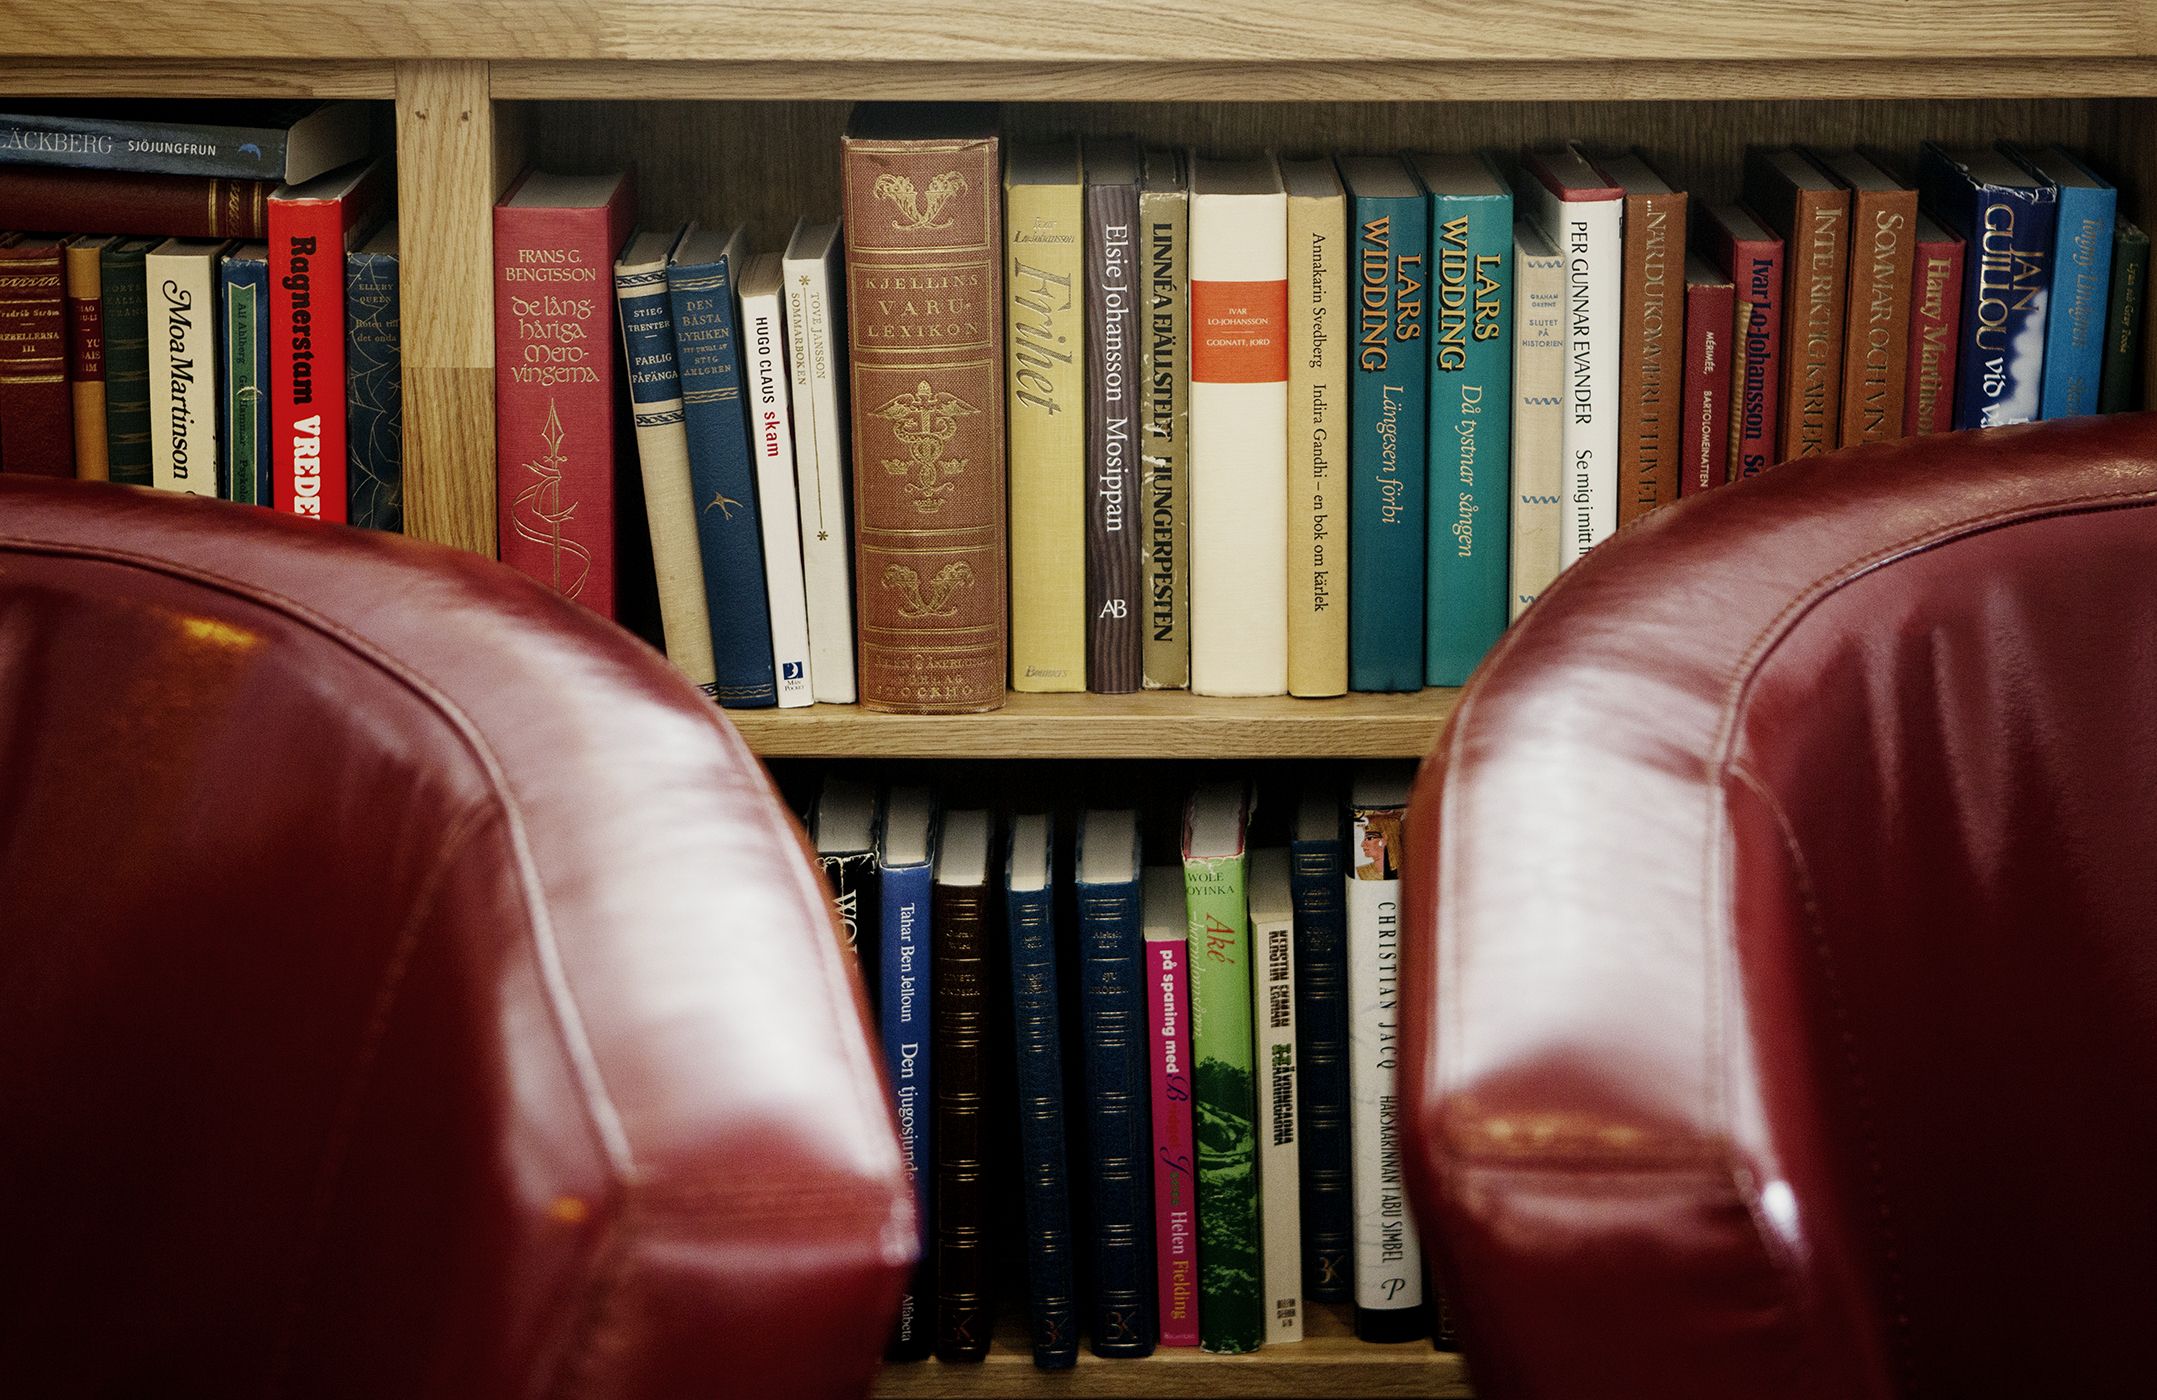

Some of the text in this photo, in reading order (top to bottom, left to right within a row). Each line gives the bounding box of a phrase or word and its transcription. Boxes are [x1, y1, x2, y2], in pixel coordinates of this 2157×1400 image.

[128, 140, 216, 156] SJÖJUNGFRUN
[519, 250, 582, 263] FRANS G.
[1571, 220, 1587, 253] PER
[1812, 206, 1842, 270] INTE
[506, 268, 596, 282] BENGTSSON
[865, 275, 978, 289] KJELLINS
[1152, 222, 1176, 309] LINNÉA
[1312, 232, 1328, 304] Annakarin
[1751, 258, 1773, 299] Ivar
[1870, 210, 1904, 324] SOMMAR
[1976, 204, 2015, 352] GUILLOU
[2008, 245, 2046, 312] JAN
[686, 300, 713, 311] DEN
[1359, 216, 1390, 373] WIDDING
[1396, 252, 1422, 341] LARS
[1437, 215, 1468, 373] WIDDING
[1473, 252, 1501, 341] LARS
[1572, 258, 1589, 335] GUNNAR
[1920, 257, 1952, 320] Harry
[628, 320, 670, 333] TRENTER
[633, 307, 663, 318] STIEG
[868, 325, 978, 337] LEXIKON
[1208, 318, 1269, 326] LO-JOHANSSON
[1529, 319, 1558, 327] SLUTET
[1538, 328, 1549, 336] PÅ
[679, 328, 729, 342] LYRIKEN
[791, 292, 806, 386] SOMMARBOKEN
[810, 292, 826, 379] TOVE JANSSON
[1014, 257, 1073, 416] Frihet
[1206, 338, 1270, 348] GODNATT, JORD
[1309, 307, 1327, 369] Svedberg
[1522, 339, 1564, 348] HISTORIEN
[162, 280, 194, 480] Moa Martinson
[283, 236, 321, 520] Ragnerstam VREDE
[632, 370, 678, 384] FÅFÄNGA
[636, 353, 672, 366] FARLIG
[695, 356, 719, 365] STIG
[1100, 223, 1129, 532] Elsie Johansson Mosippan
[1744, 302, 1772, 440] Lo-Johansson
[1982, 357, 2006, 398] vid
[756, 316, 779, 457] HUGO CLAUS skam
[1313, 384, 1328, 423] Indira
[1574, 343, 1592, 424] EVANDER
[1313, 428, 1329, 478] Gandhi
[1375, 384, 1404, 524] Längesen förbi
[1575, 450, 1593, 470] Se
[1700, 390, 1713, 488] BARTOLOMEINATTEN
[1452, 384, 1483, 558] Då tystnar sången
[1573, 474, 1593, 503] mig
[1314, 494, 1323, 511] en
[1314, 515, 1328, 540] bok
[1578, 513, 1594, 543] mitt
[1152, 456, 1173, 642] HUNGERPESTEN
[1314, 545, 1323, 567] om
[1314, 571, 1329, 612] kärlek
[1187, 872, 1224, 882] WOLE
[832, 889, 857, 954] WO
[900, 902, 915, 941] Tahar
[1206, 913, 1236, 964] Aké
[900, 945, 915, 969] Ben
[1160, 949, 1178, 970] på
[1378, 901, 1398, 1009] CHRISTIAN
[901, 972, 915, 1023] Jelloun
[1161, 973, 1178, 1036] spaning
[901, 1043, 918, 1078] Den
[1166, 1039, 1180, 1073] med
[1376, 1021, 1398, 1070] JACQ
[1382, 1194, 1401, 1217] ABU
[1171, 1211, 1188, 1254] Helen
[1382, 1221, 1403, 1263] SIMBEL
[1171, 1260, 1190, 1320] Fielding
